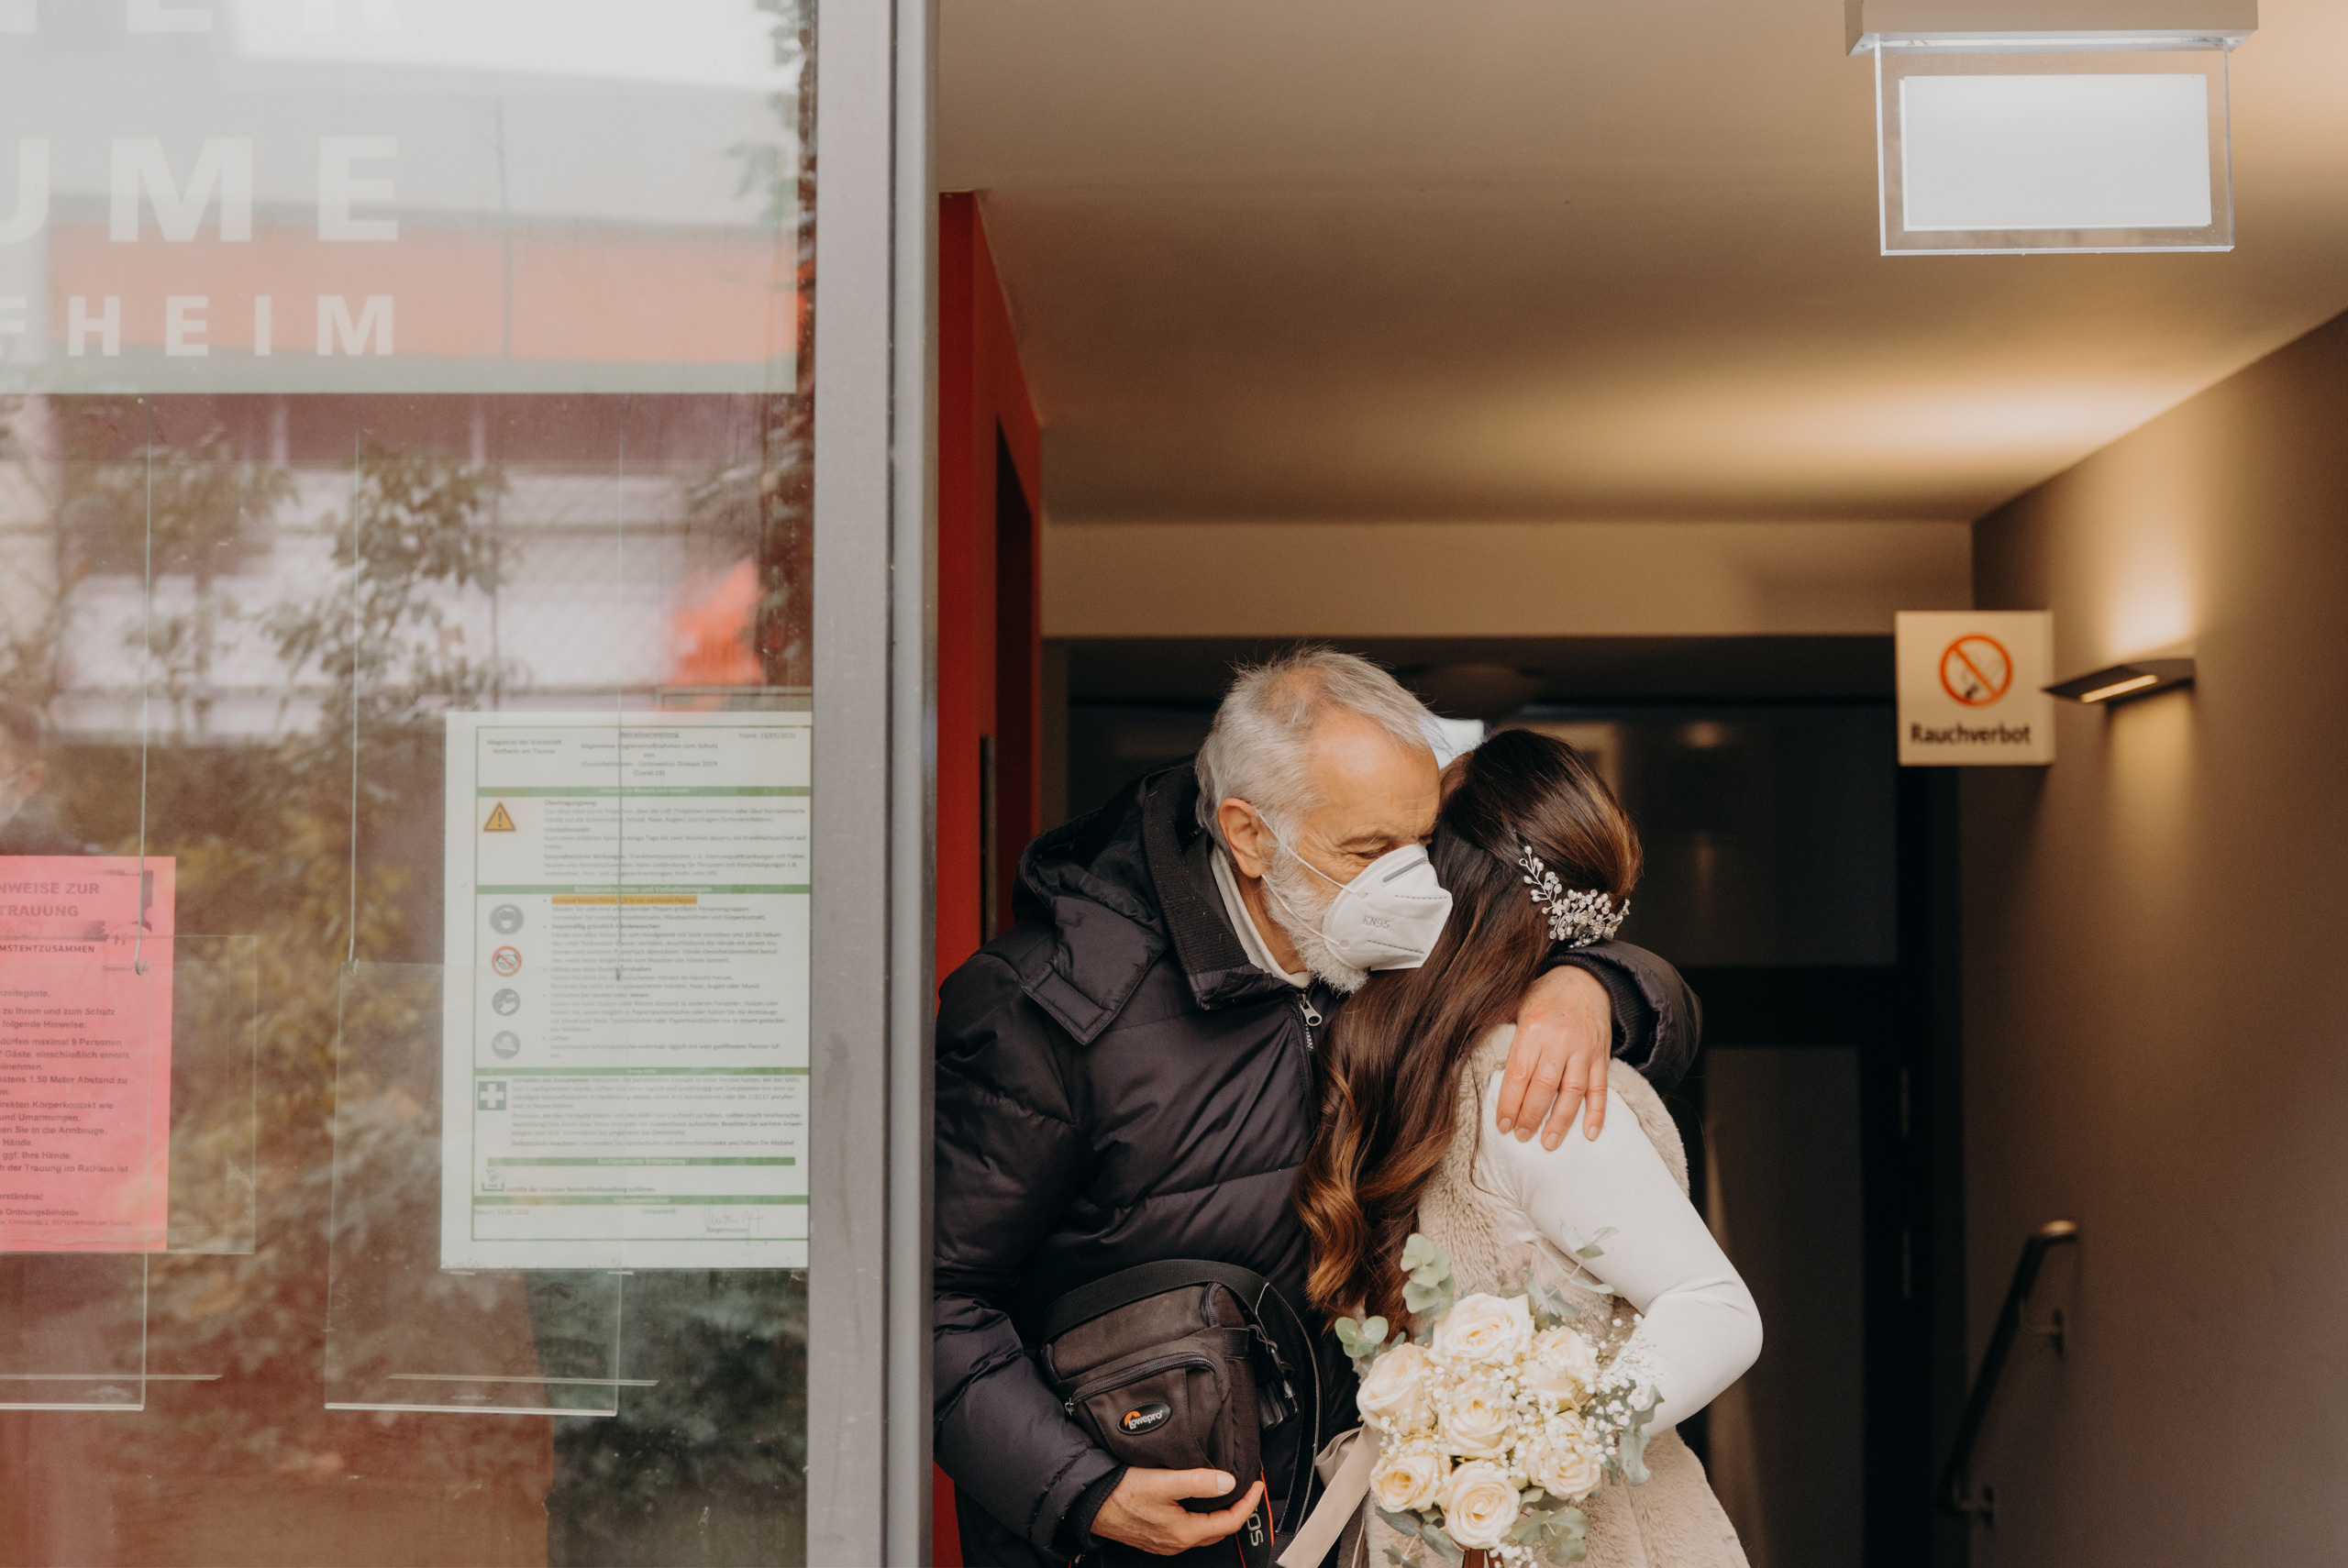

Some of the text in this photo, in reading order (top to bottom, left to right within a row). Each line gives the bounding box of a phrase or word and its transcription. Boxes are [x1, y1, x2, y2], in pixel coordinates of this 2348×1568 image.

[1911, 721, 2031, 744] Rauchverbot
[65, 883, 99, 894] ZUR
[0, 905, 79, 917] TRAUUNG
[1362, 916, 1392, 930] KN95
[16, 1007, 41, 1015] Ihrem
[84, 1008, 116, 1016] Schutz
[3, 1020, 41, 1029] folgende
[79, 1038, 122, 1046] Personen
[36, 1050, 98, 1058] einschließlich
[77, 1076, 115, 1084] Abstand
[32, 1100, 96, 1110] Körperkontakt
[98, 1101, 114, 1110] wie
[18, 1113, 81, 1123] Umarmungen.
[15, 1126, 29, 1134] Sie
[32, 1126, 39, 1134] in
[42, 1126, 56, 1134] die
[59, 1126, 107, 1136] Armbeuge,
[3, 1152, 19, 1161] ggf.
[42, 1152, 72, 1160] Hände.
[25, 1164, 61, 1174] Trauung
[78, 1165, 115, 1173] Rathaus
[117, 1165, 128, 1173] ist
[6, 1208, 80, 1217] Ordnungsbehörde
[1128, 1413, 1162, 1430] Lowepro
[1247, 1507, 1264, 1547] OS
